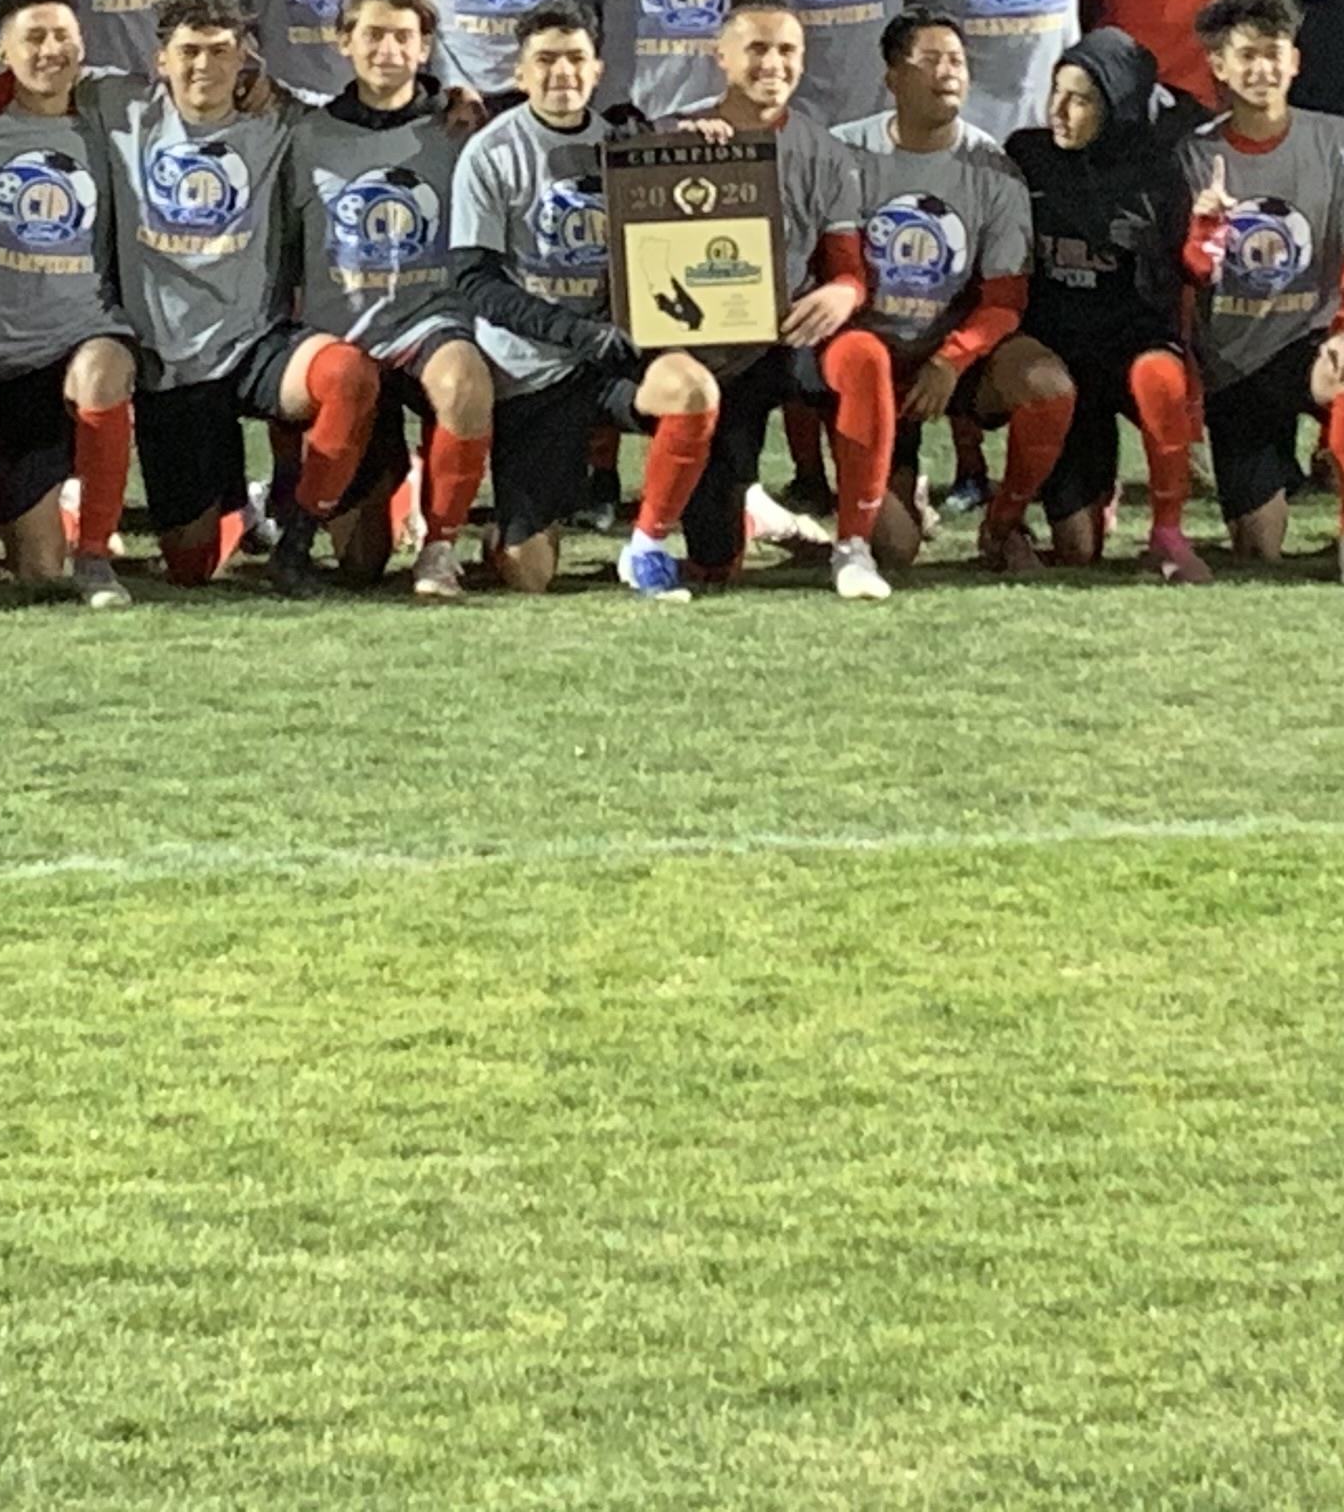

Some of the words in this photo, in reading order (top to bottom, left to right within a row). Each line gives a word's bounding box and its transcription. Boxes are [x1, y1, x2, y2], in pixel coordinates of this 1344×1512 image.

[627, 145, 758, 166] CHAMPIONS
[629, 186, 666, 208] 20
[721, 182, 758, 205] 20
